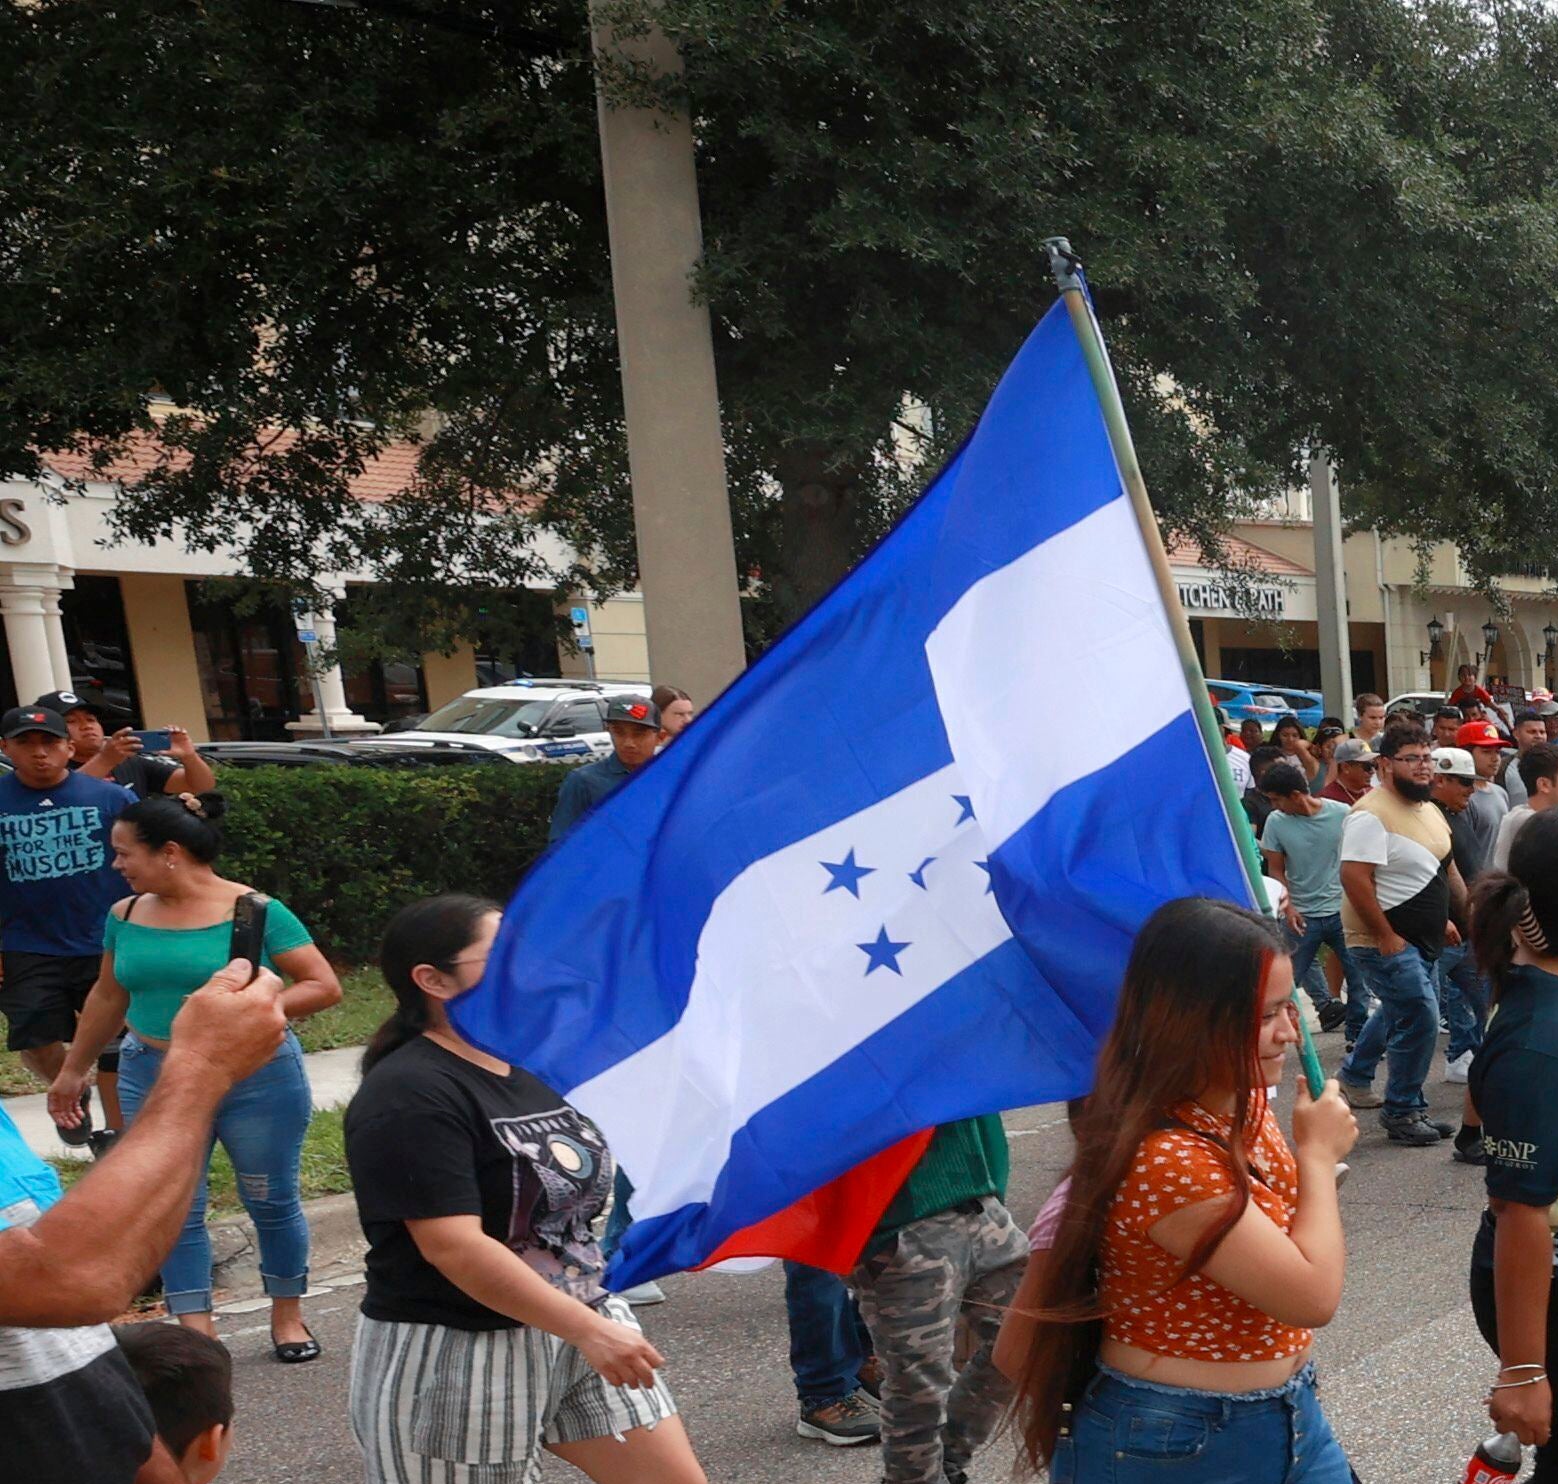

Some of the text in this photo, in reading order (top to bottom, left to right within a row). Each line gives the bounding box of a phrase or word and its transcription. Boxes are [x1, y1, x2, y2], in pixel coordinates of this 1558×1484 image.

[1177, 583, 1230, 607] TCHEN
[1, 809, 97, 841] HUSTLE
[14, 832, 83, 856] FOR THE
[9, 846, 100, 879] MUSCLE
[1497, 1139, 1537, 1160] GNP
